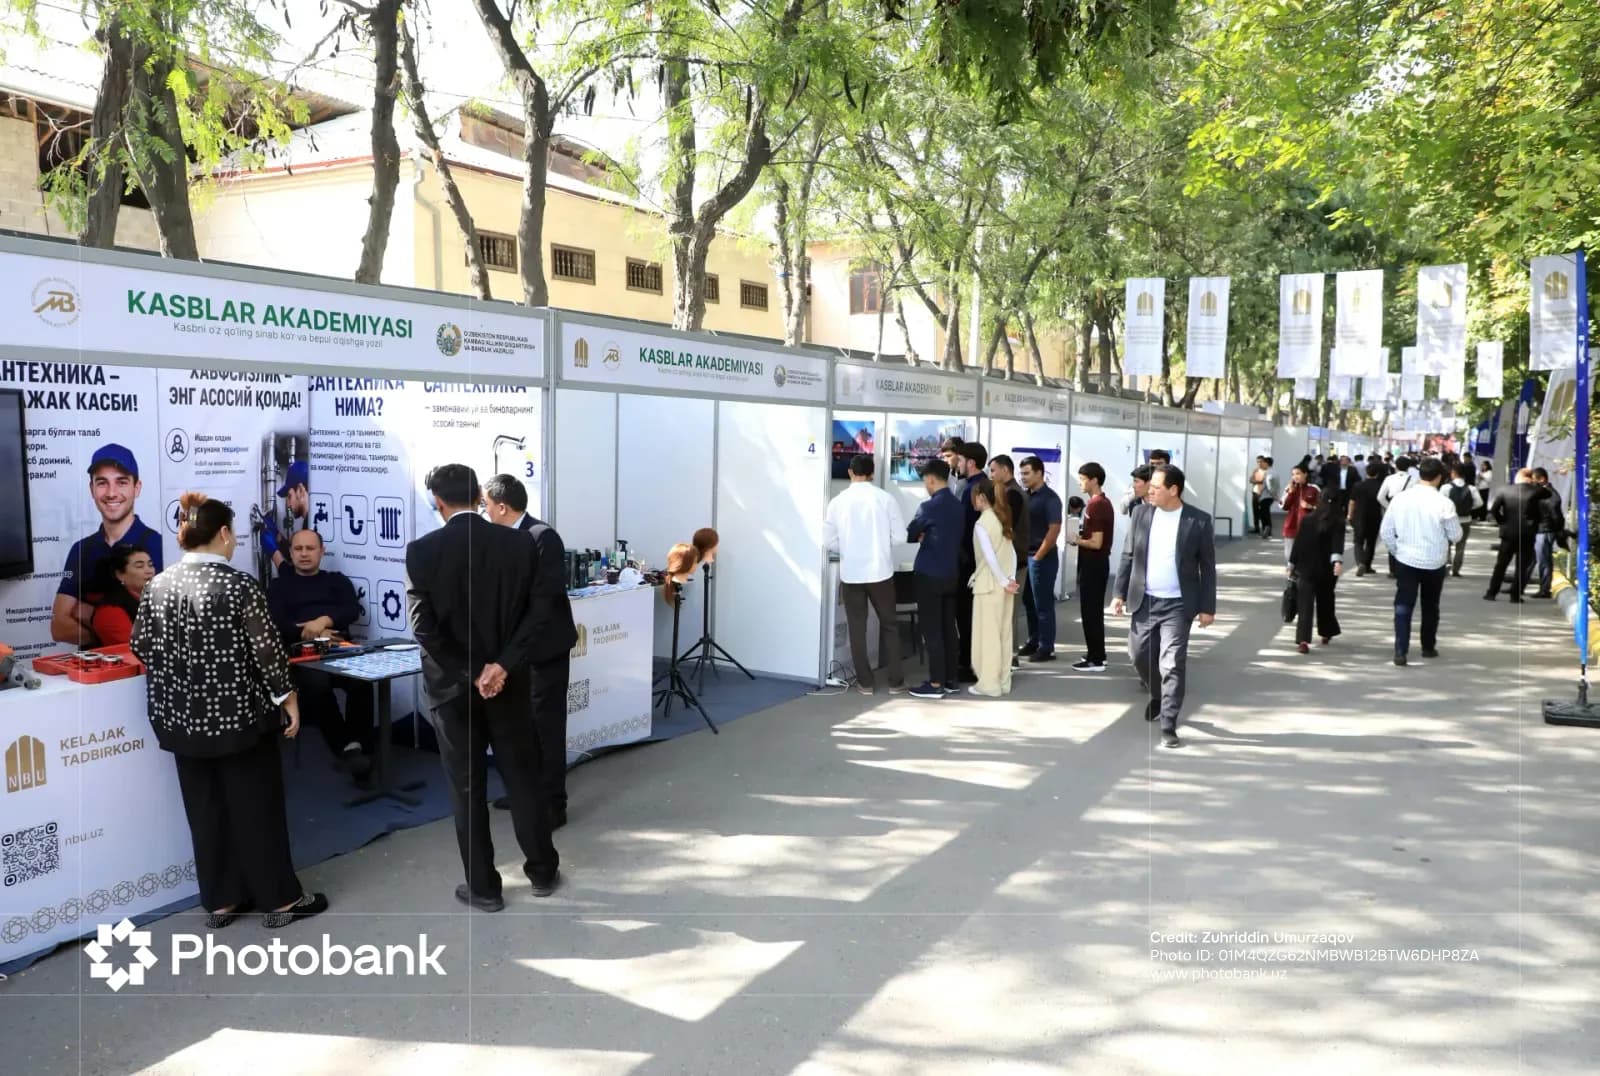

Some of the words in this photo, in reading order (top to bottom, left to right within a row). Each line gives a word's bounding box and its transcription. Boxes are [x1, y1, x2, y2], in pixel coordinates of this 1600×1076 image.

[128, 290, 255, 324] KASBLAR
[262, 305, 413, 339] AKADEMIYASI
[173, 322, 206, 334] Kasbni
[255, 328, 278, 340] sinab
[297, 333, 307, 342] va
[309, 333, 331, 346] bepul
[639, 347, 693, 368] KASBLAR
[695, 354, 764, 376] AKADEMIYASI
[24, 390, 71, 410] ЖАК
[76, 391, 138, 412] КАСБИ!
[169, 386, 197, 405] ЭНГ
[199, 385, 253, 407] АСОСИЙ
[334, 396, 384, 417] НИМА?
[48, 426, 76, 439] бўлган
[78, 428, 101, 437] талаб
[807, 442, 816, 455] 4
[28, 470, 57, 480] ракли!
[525, 461, 534, 478] 3
[59, 726, 126, 751] KELAJAK
[61, 738, 145, 767] TADBIRKORI
[8, 770, 45, 788] NBU
[64, 828, 104, 847] nbu.uz
